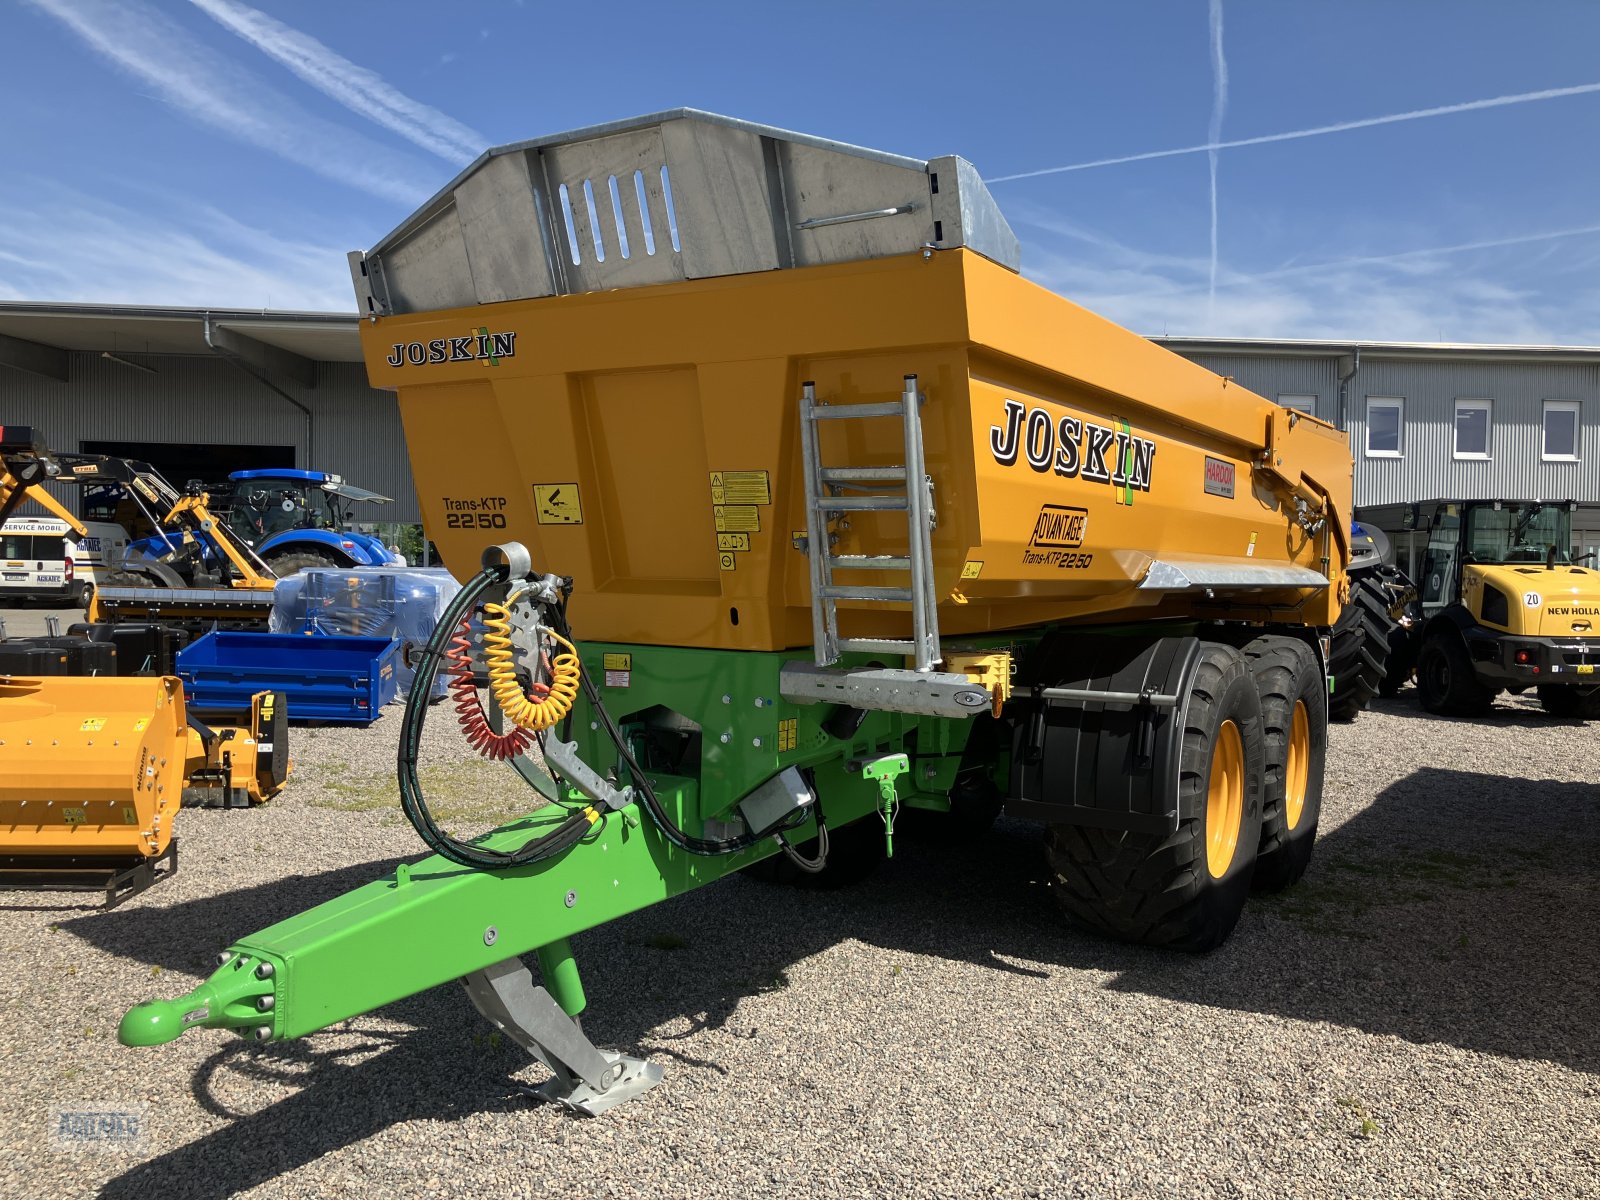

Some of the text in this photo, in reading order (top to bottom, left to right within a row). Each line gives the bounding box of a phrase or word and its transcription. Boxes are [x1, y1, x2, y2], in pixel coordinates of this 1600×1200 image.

[386, 332, 516, 367] JOSKIN
[990, 399, 1156, 492] JOSKIN
[1207, 461, 1234, 485] HARDOX
[442, 497, 507, 510] Trans-KTP
[1028, 512, 1084, 546] ADVANTAGE
[1023, 549, 1061, 565] Trans-KTP
[1526, 594, 1539, 605] 20
[1547, 607, 1570, 615] NEW
